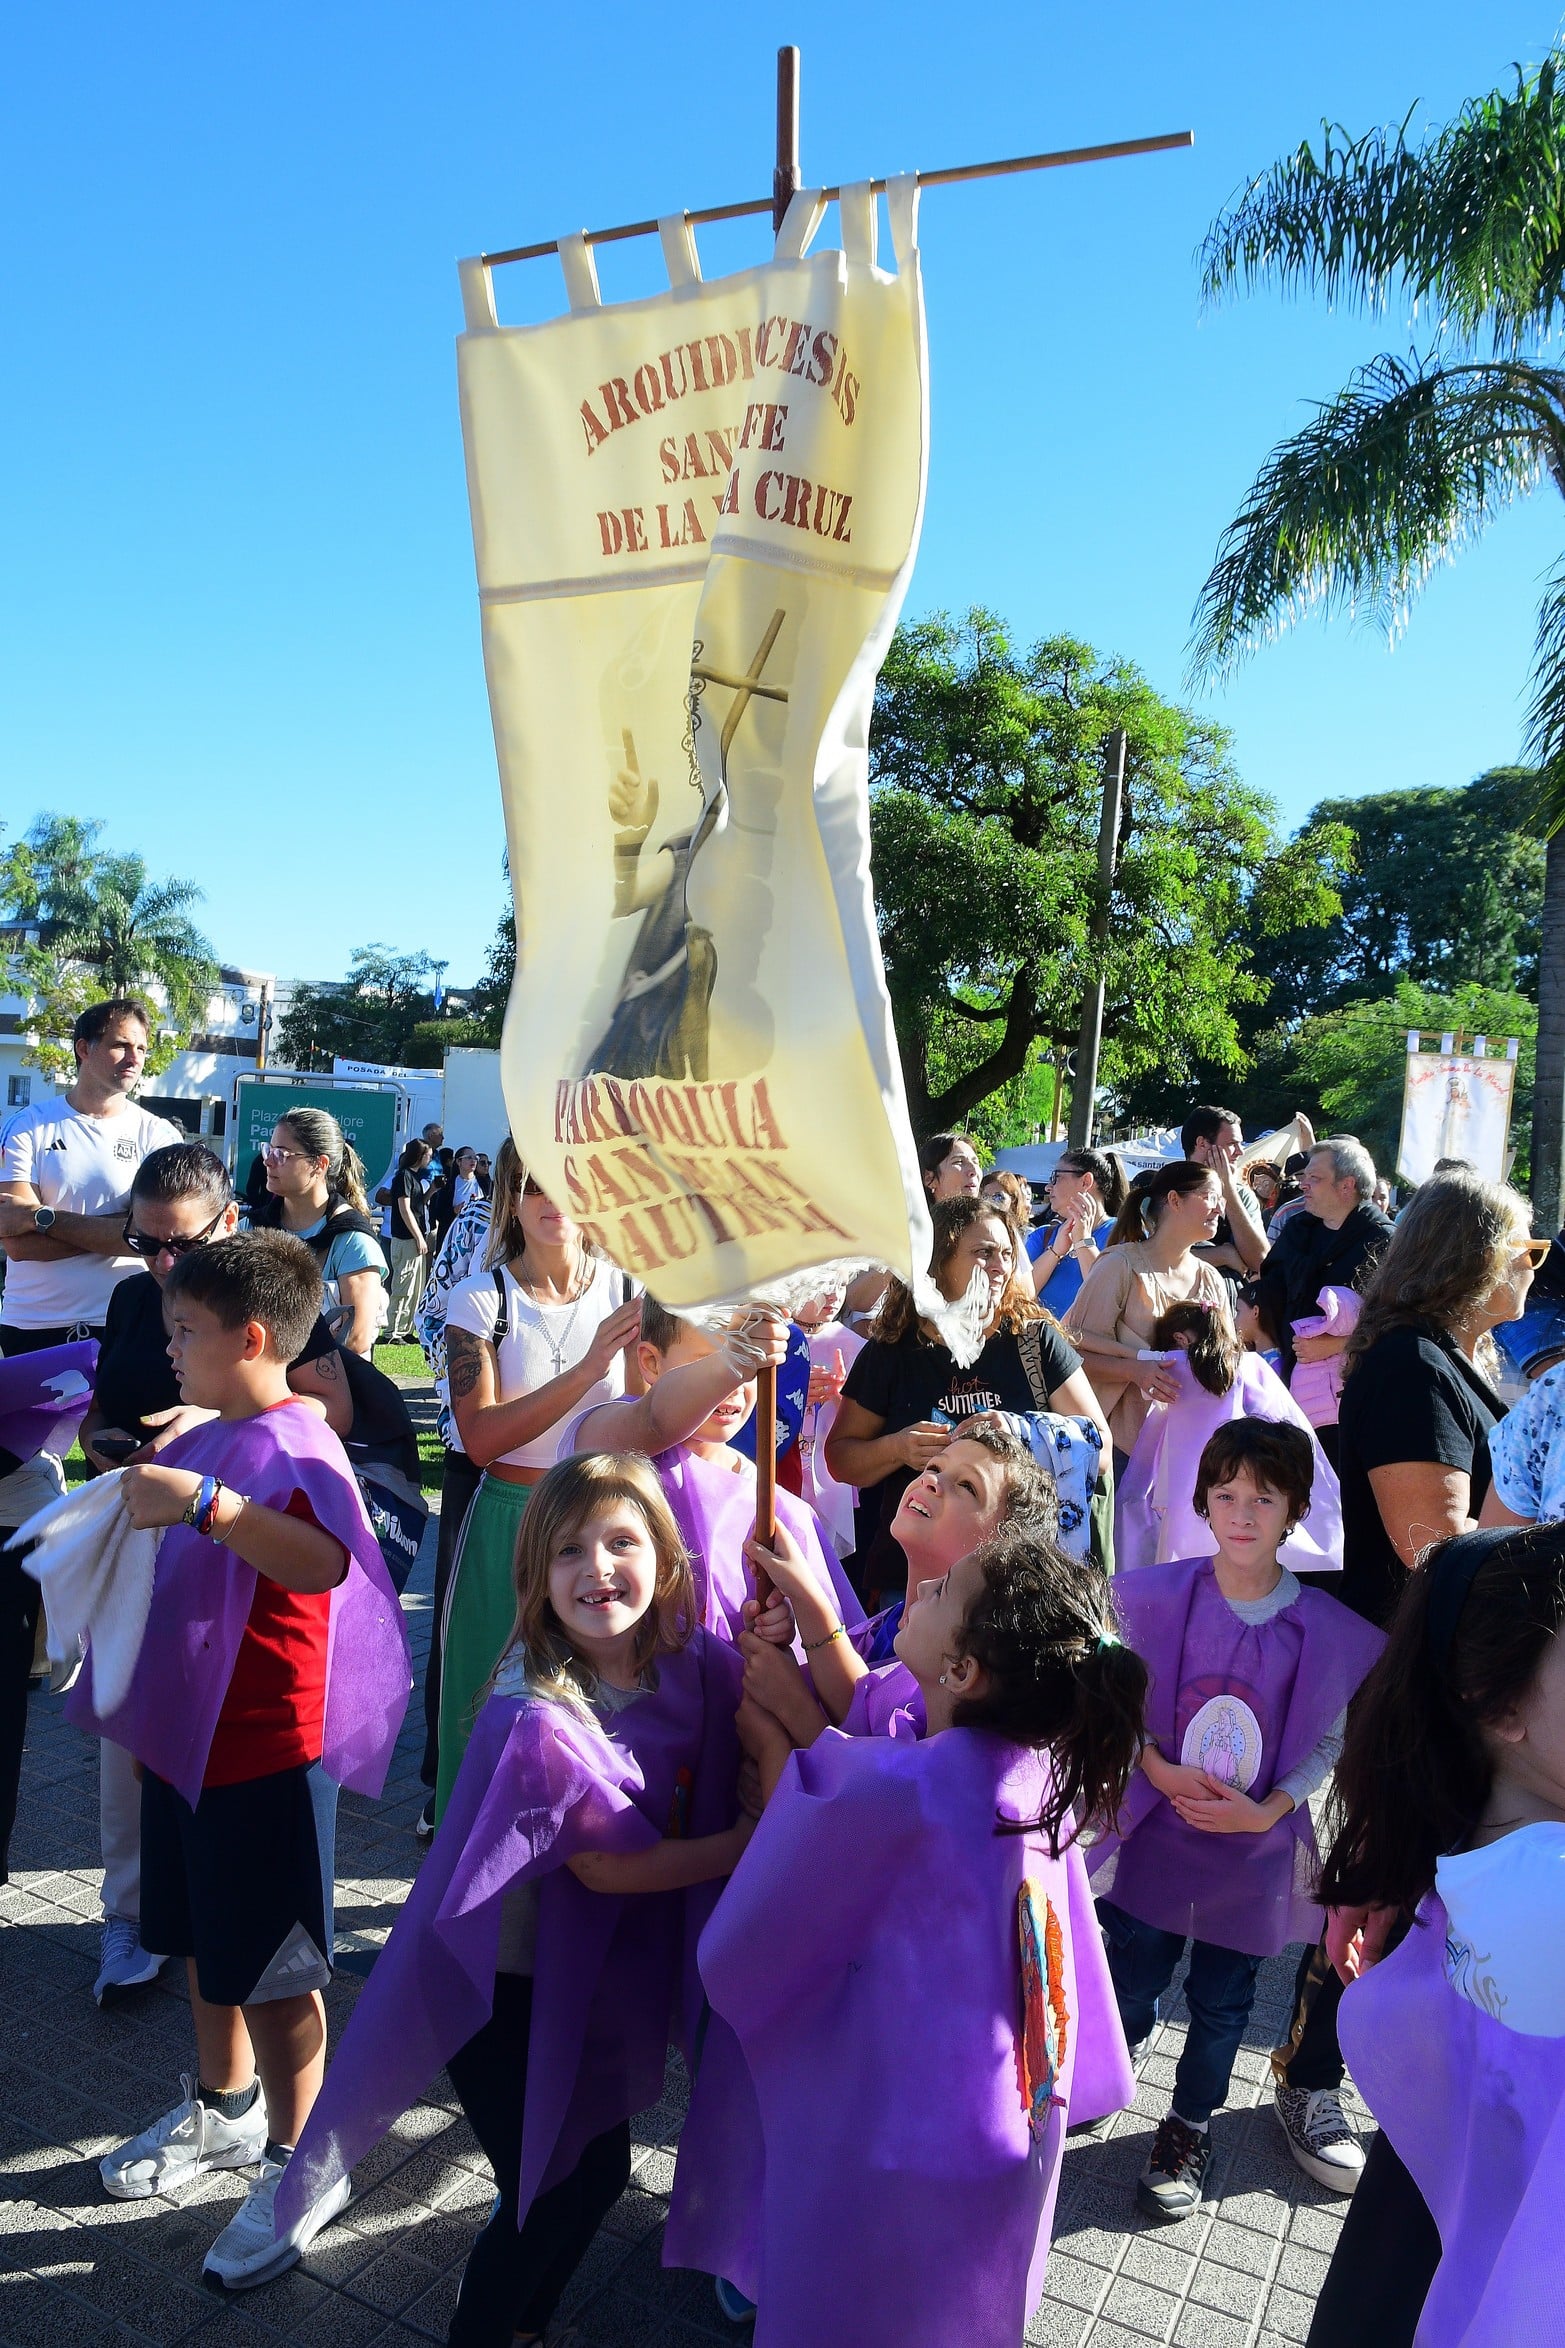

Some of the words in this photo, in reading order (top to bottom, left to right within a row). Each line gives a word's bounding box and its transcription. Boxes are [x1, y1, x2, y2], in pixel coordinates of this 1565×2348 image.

[739, 404, 788, 452] FE
[597, 507, 649, 556] DE
[656, 498, 707, 549] LA
[754, 470, 853, 544] CRUZ
[347, 1065, 387, 1075] POSADA
[251, 1109, 279, 1123] Plaz
[564, 1144, 672, 1217] SAN
[947, 1375, 990, 1395] hot
[937, 1391, 1003, 1415] SUMMER
